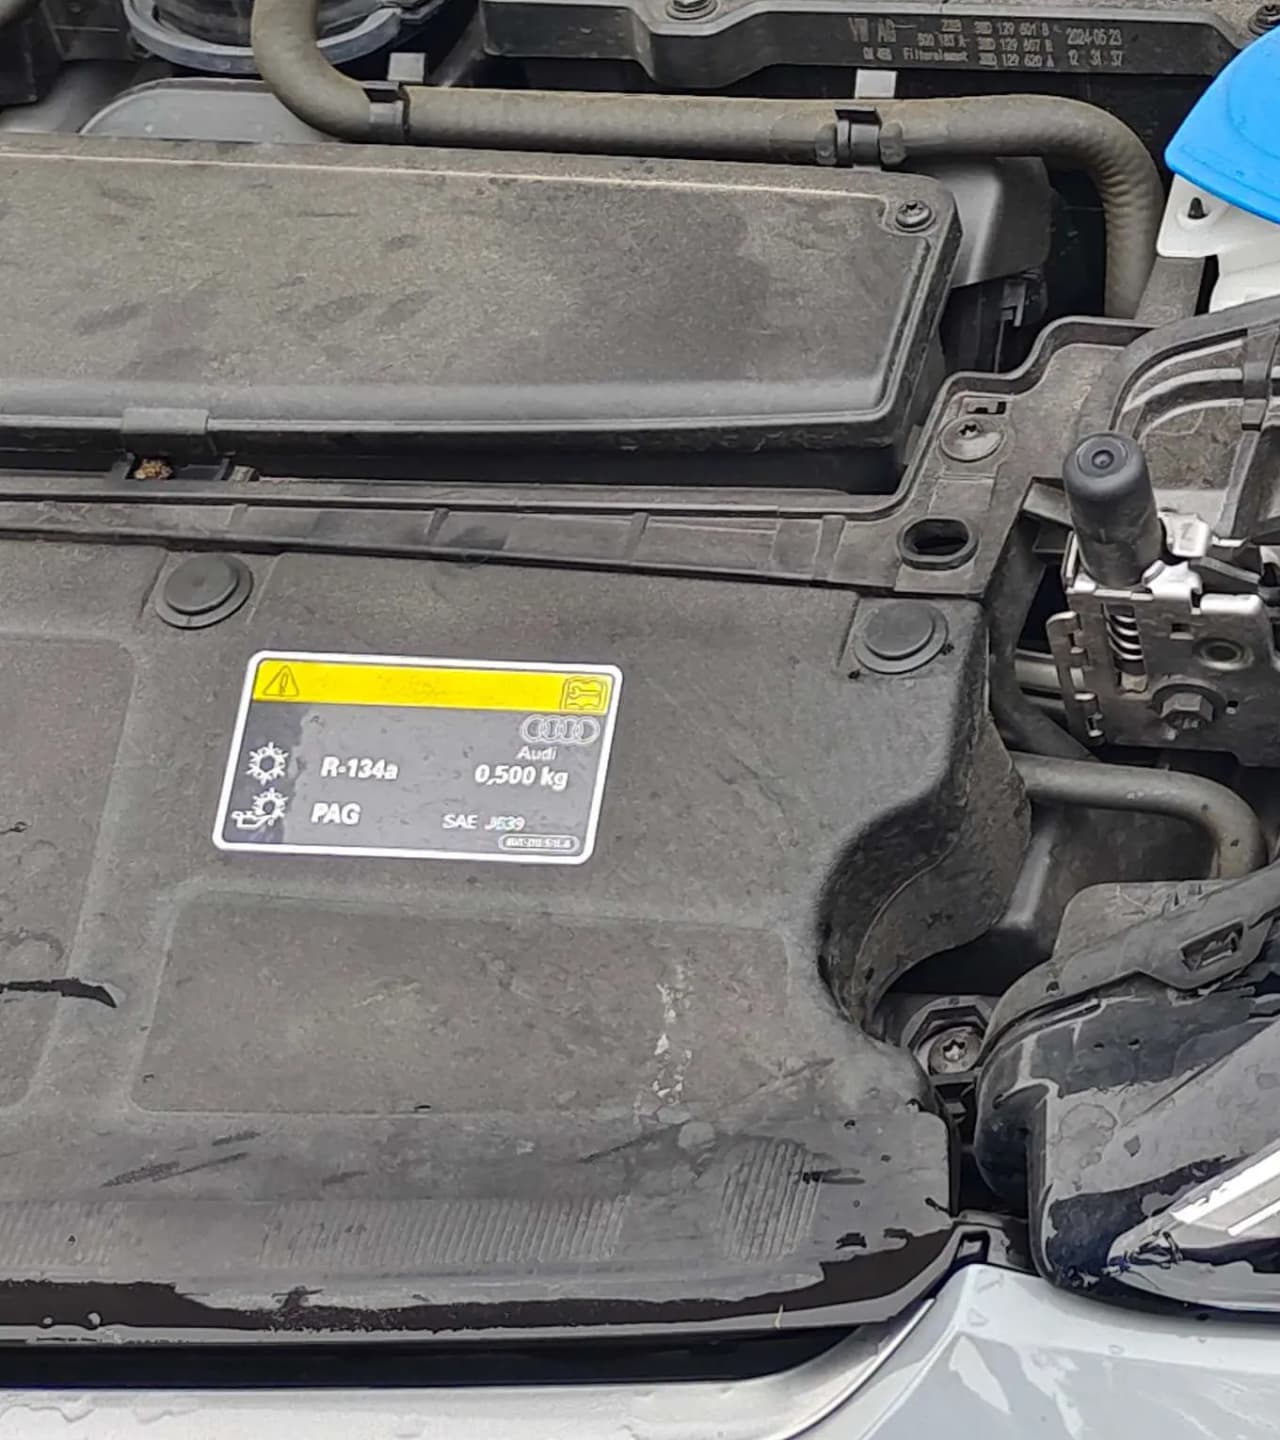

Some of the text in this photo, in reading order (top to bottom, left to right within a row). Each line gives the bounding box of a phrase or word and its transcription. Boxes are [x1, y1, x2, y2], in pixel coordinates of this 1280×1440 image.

[516, 746, 558, 761] Audi
[321, 756, 569, 791] R-134a 0,500 kg
[311, 802, 361, 825] PAG
[442, 814, 478, 829] SAE
